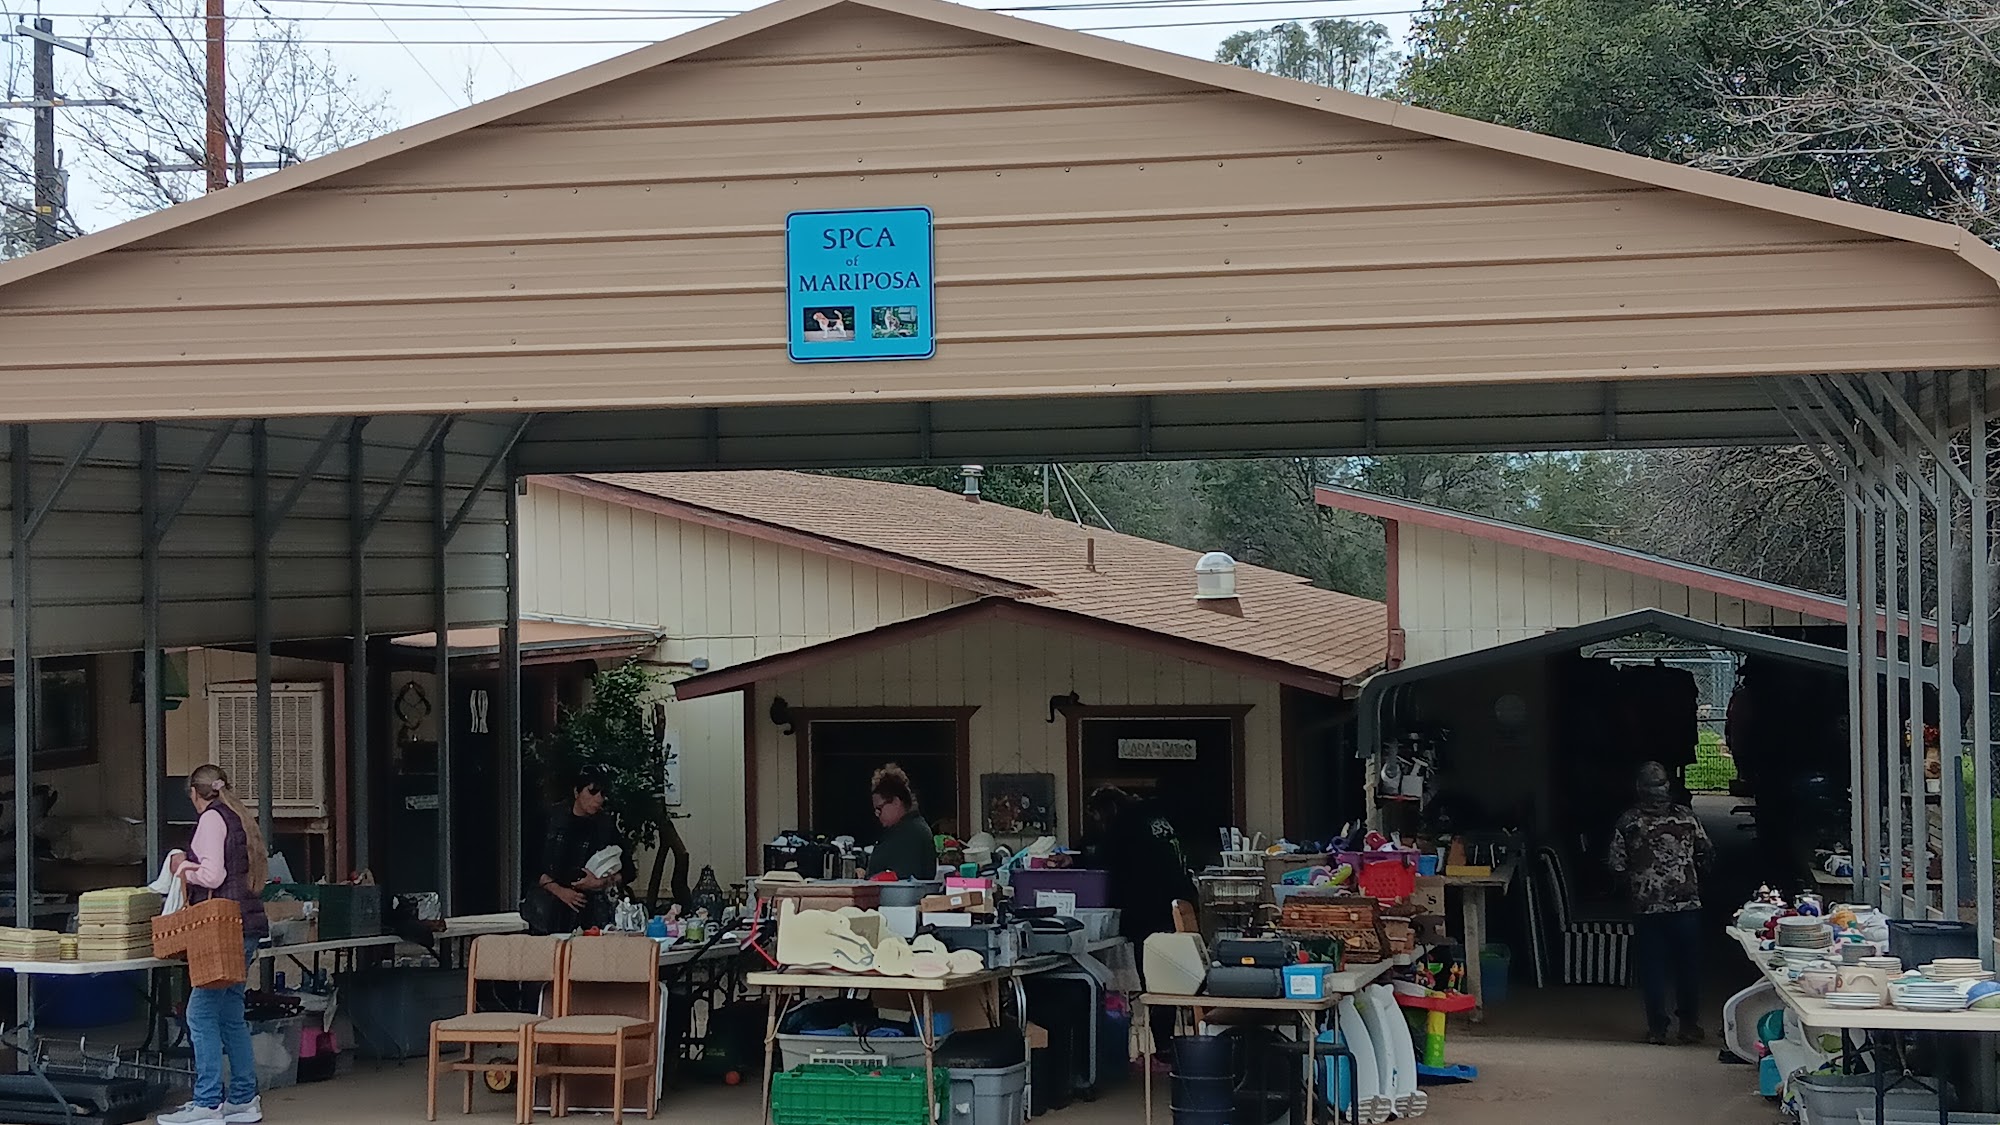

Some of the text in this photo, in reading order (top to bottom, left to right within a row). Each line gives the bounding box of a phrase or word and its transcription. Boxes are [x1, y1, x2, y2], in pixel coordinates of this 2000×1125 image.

[822, 227, 896, 249] SPCA
[845, 255, 859, 266] of
[798, 271, 921, 292] MARIPOSA
